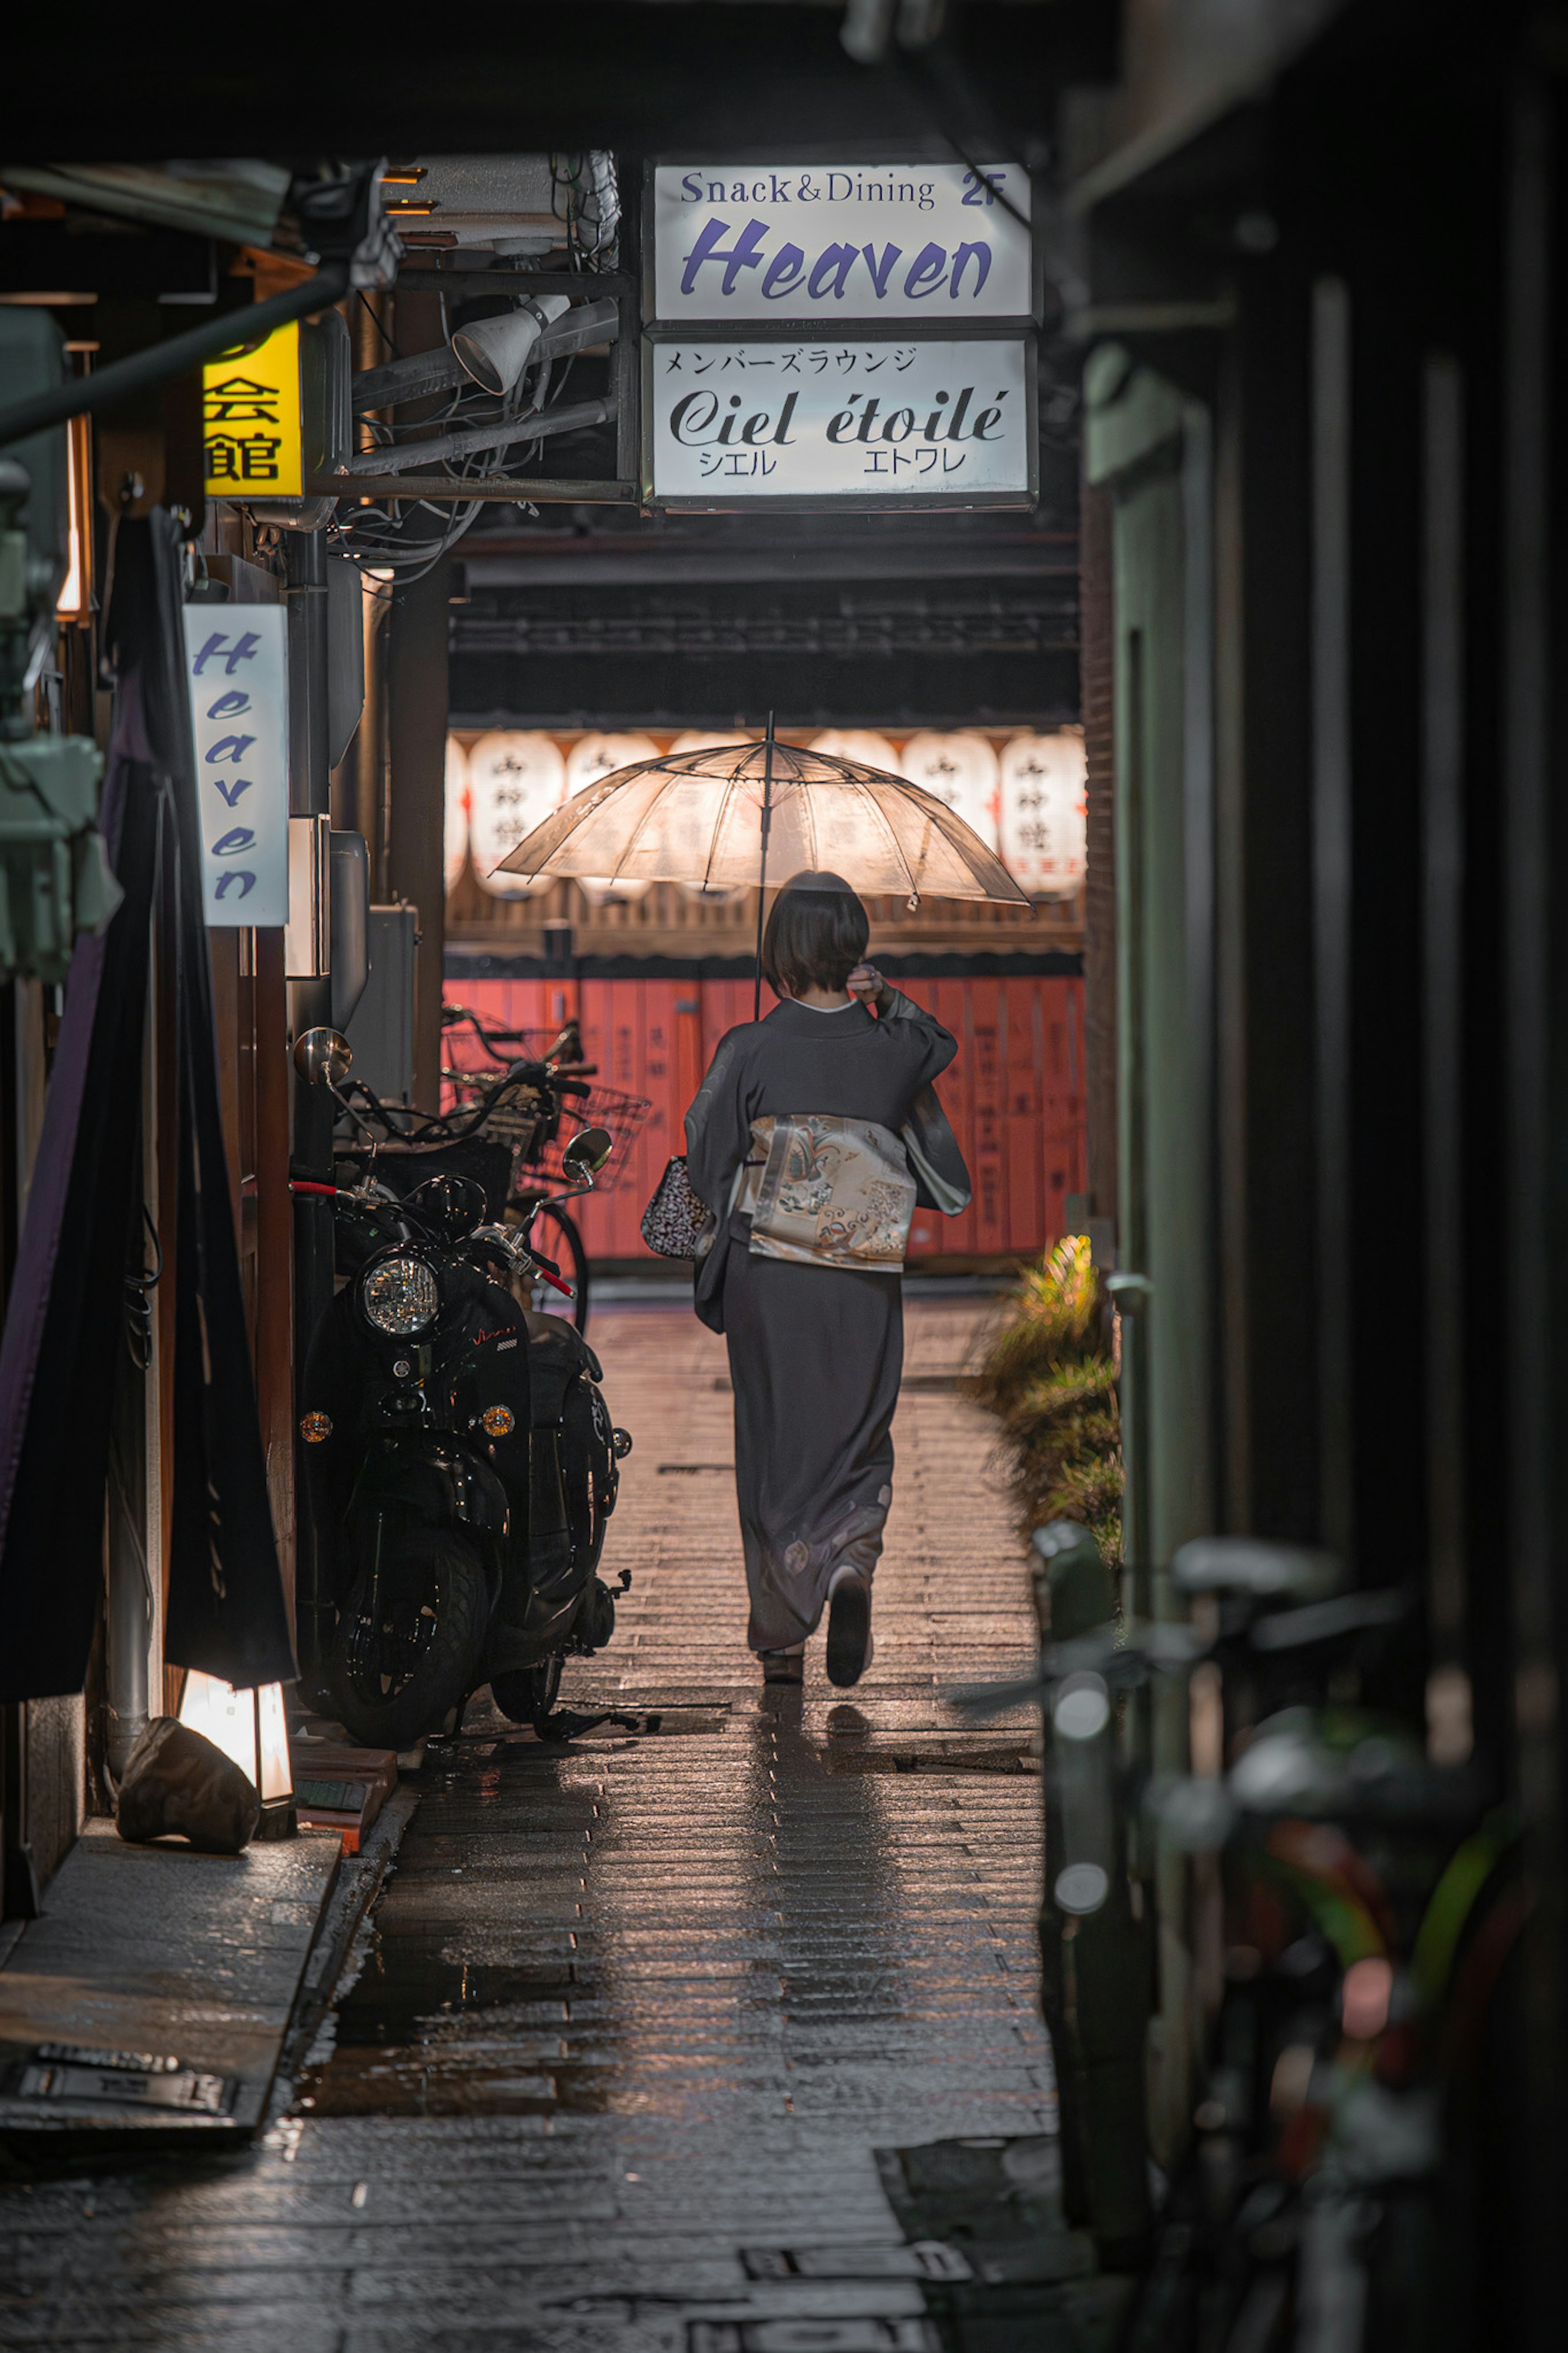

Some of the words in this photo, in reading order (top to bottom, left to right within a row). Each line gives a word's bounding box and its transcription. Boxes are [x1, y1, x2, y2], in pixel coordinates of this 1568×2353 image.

[961, 172, 1007, 206] 2F
[680, 217, 992, 300] Heaven
[666, 347, 916, 375] メンバーズラウンジ
[669, 390, 800, 447] Ciel
[825, 386, 1009, 444] étoilé
[699, 450, 777, 477] シエル
[863, 447, 967, 475] エトワレ
[193, 632, 262, 900] Heaven
